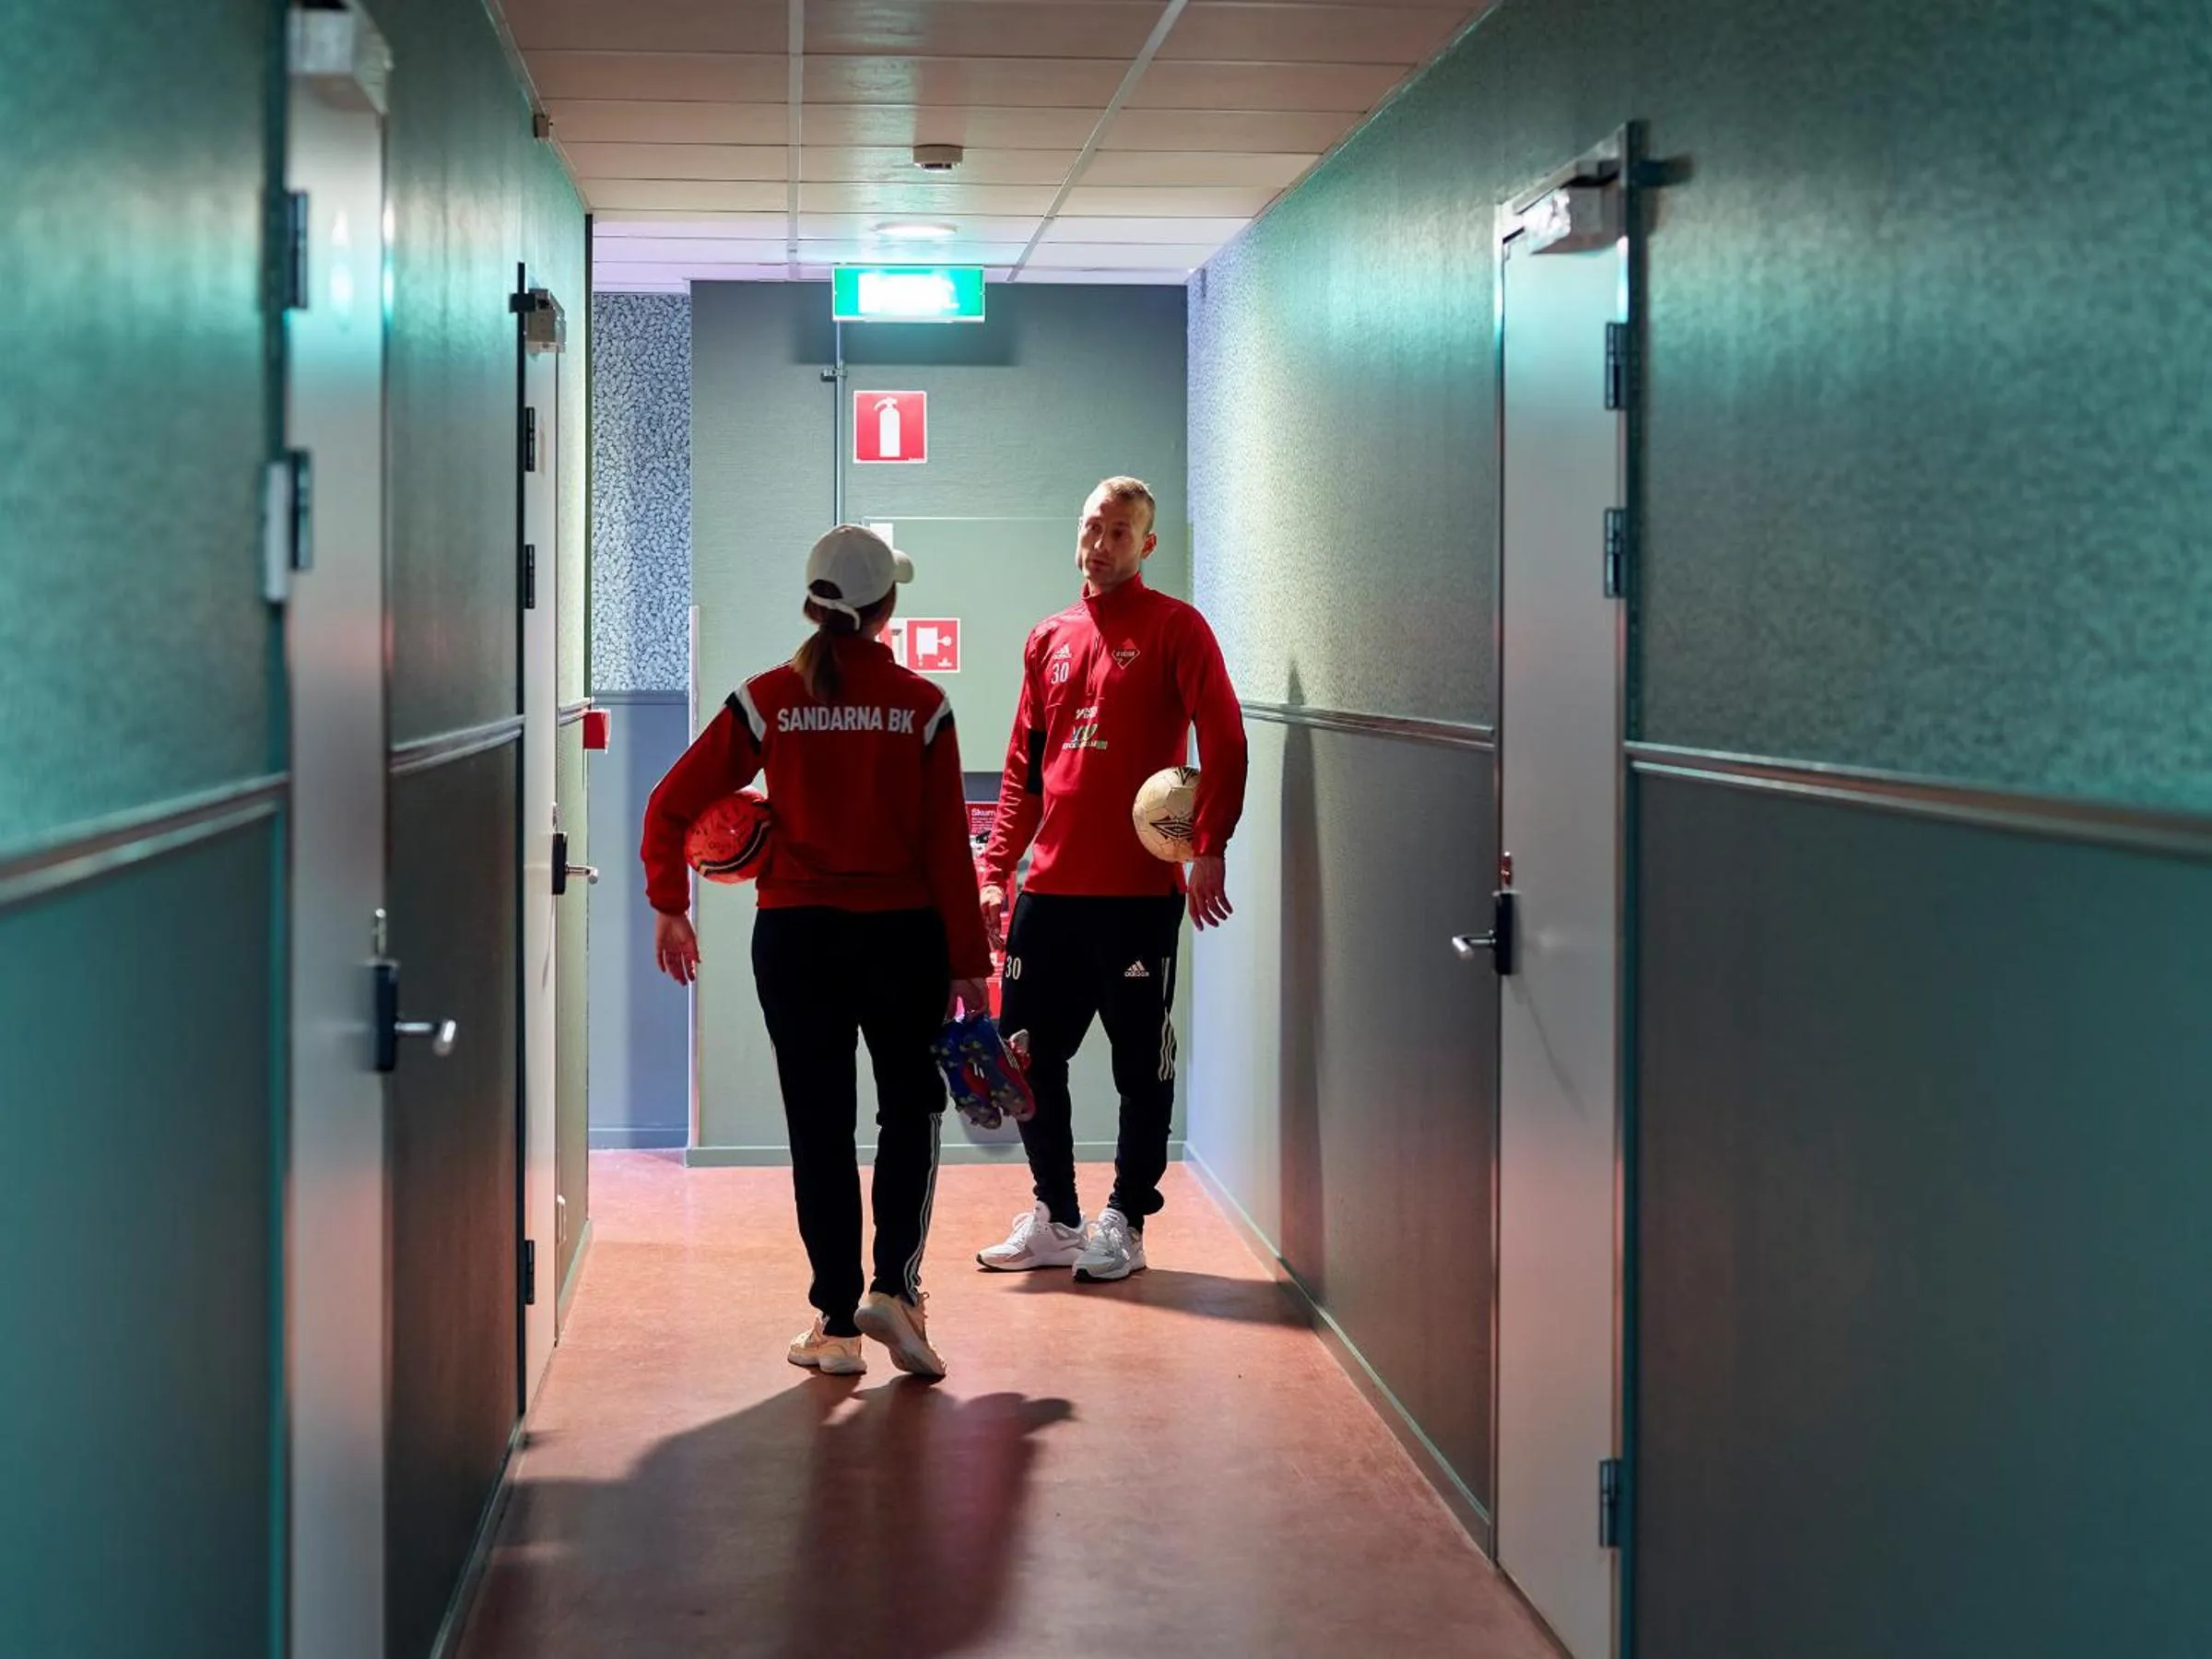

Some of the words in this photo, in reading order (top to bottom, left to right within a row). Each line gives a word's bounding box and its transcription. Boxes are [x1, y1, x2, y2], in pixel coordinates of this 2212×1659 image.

[1051, 662, 1070, 685] 30
[777, 705, 884, 733] SANDARNA
[888, 708, 915, 734] BK
[1006, 955, 1022, 980] 30
